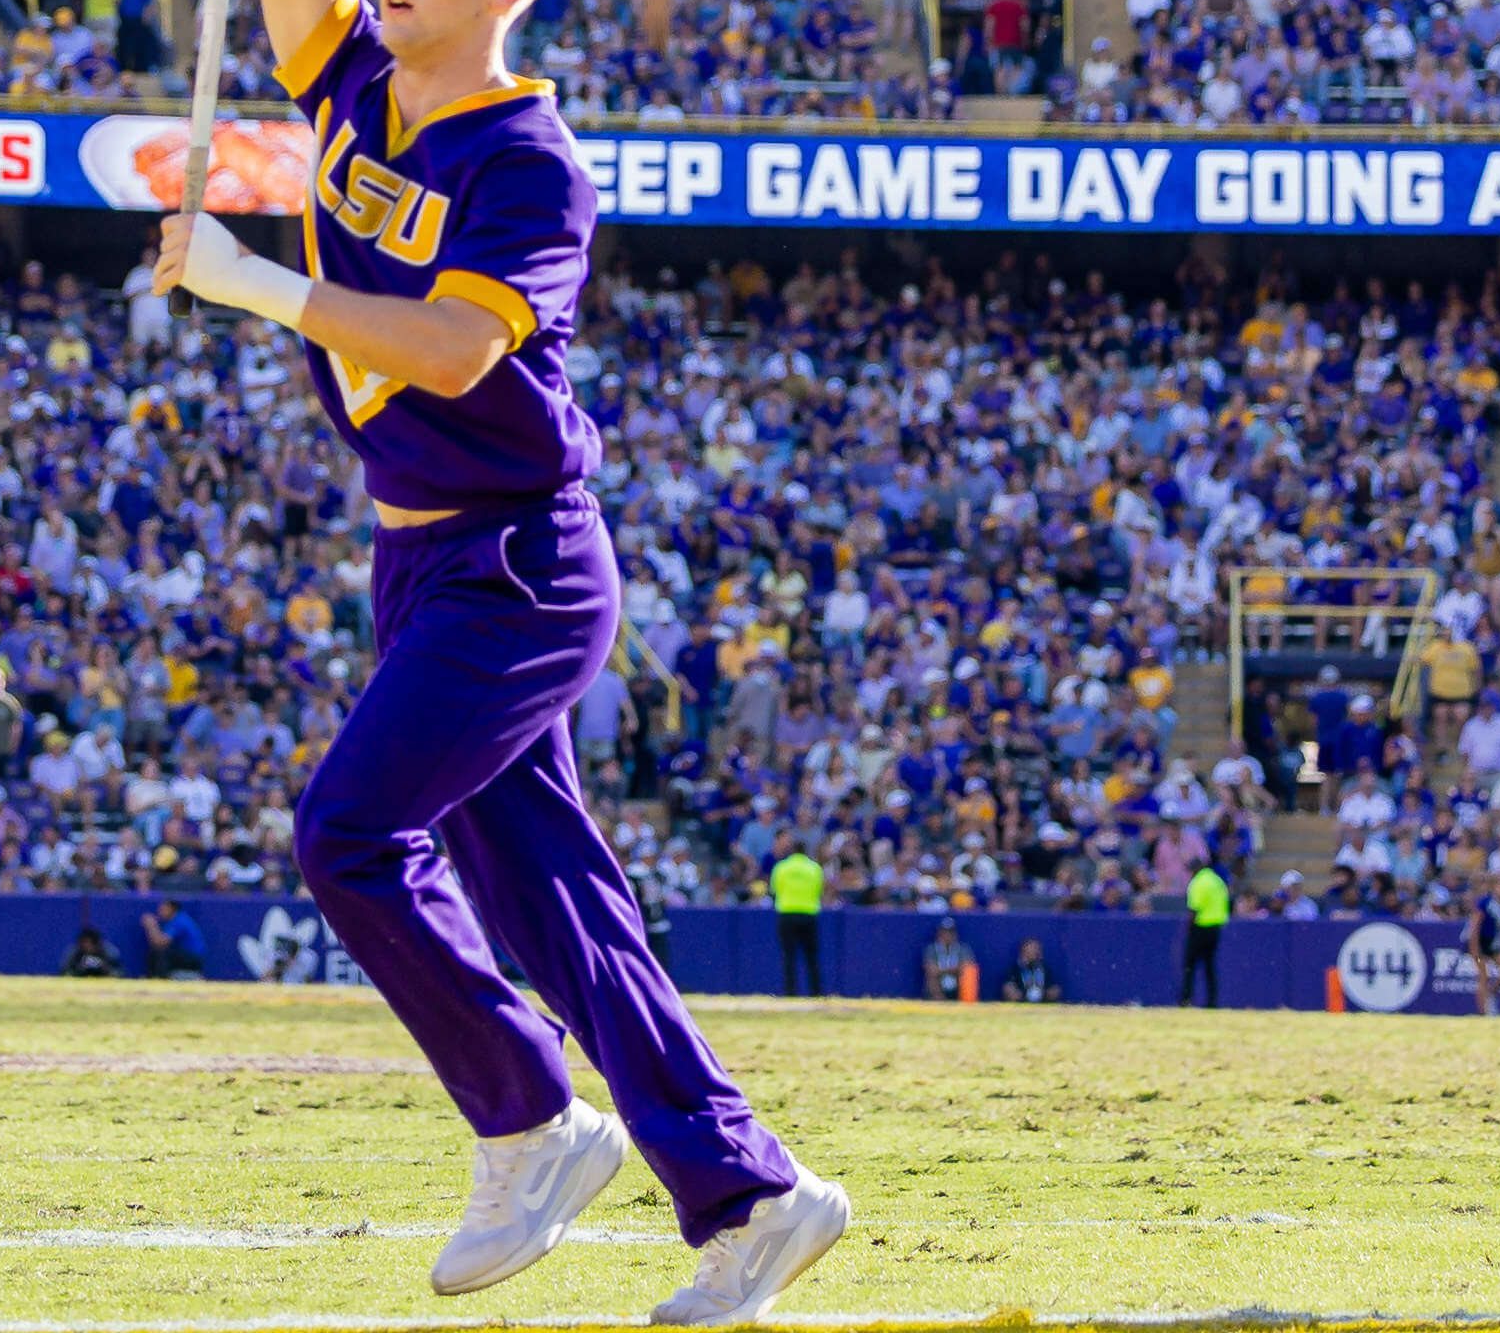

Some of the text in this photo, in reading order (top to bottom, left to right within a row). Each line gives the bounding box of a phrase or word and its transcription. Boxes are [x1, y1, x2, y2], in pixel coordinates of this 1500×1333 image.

[315, 118, 452, 268] LSU
[578, 138, 722, 217] EEP
[746, 143, 983, 221] GAME
[1007, 147, 1172, 224] DAY
[1195, 148, 1444, 225] GOING
[1348, 948, 1415, 989] 44
